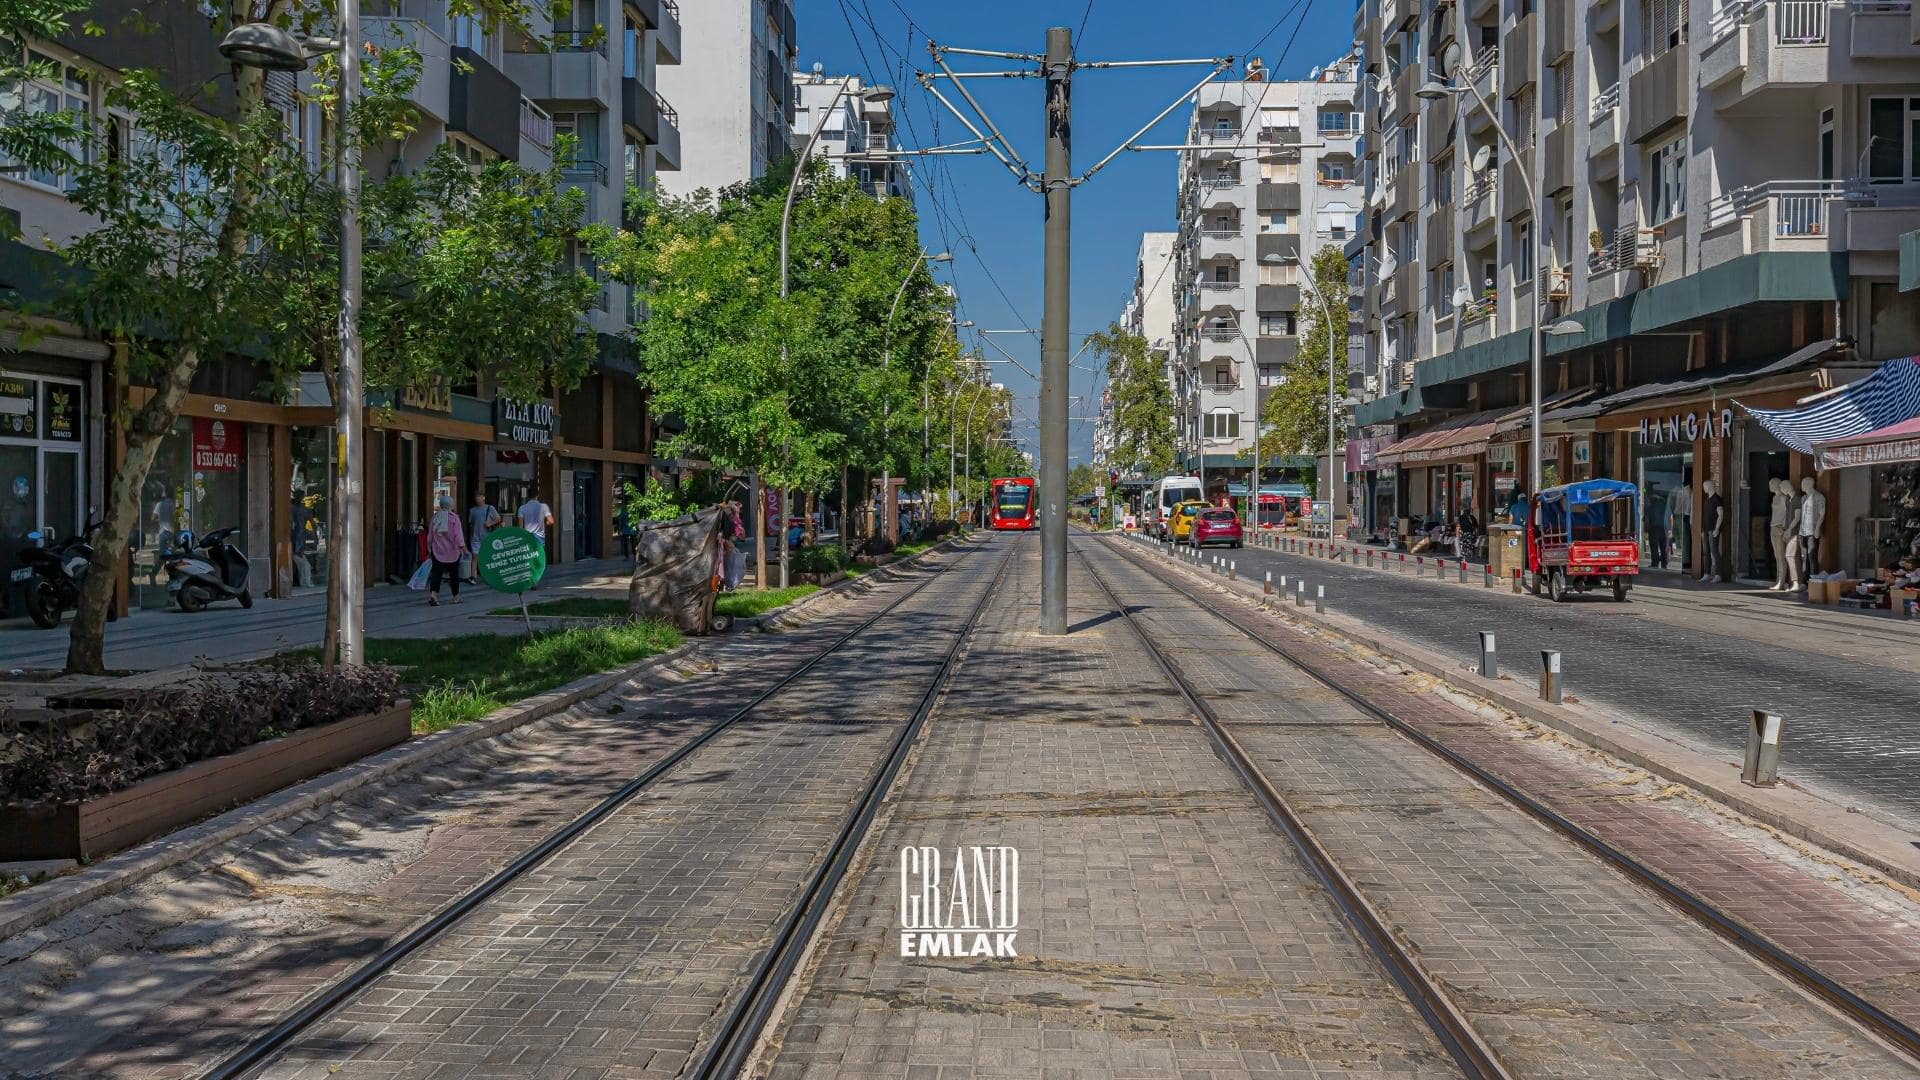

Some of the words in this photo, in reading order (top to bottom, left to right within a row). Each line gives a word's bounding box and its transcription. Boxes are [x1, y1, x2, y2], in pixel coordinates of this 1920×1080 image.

[0, 382, 24, 395] ГАЗИН
[533, 403, 554, 431] KOÇ
[1640, 408, 1732, 445] HANGAR
